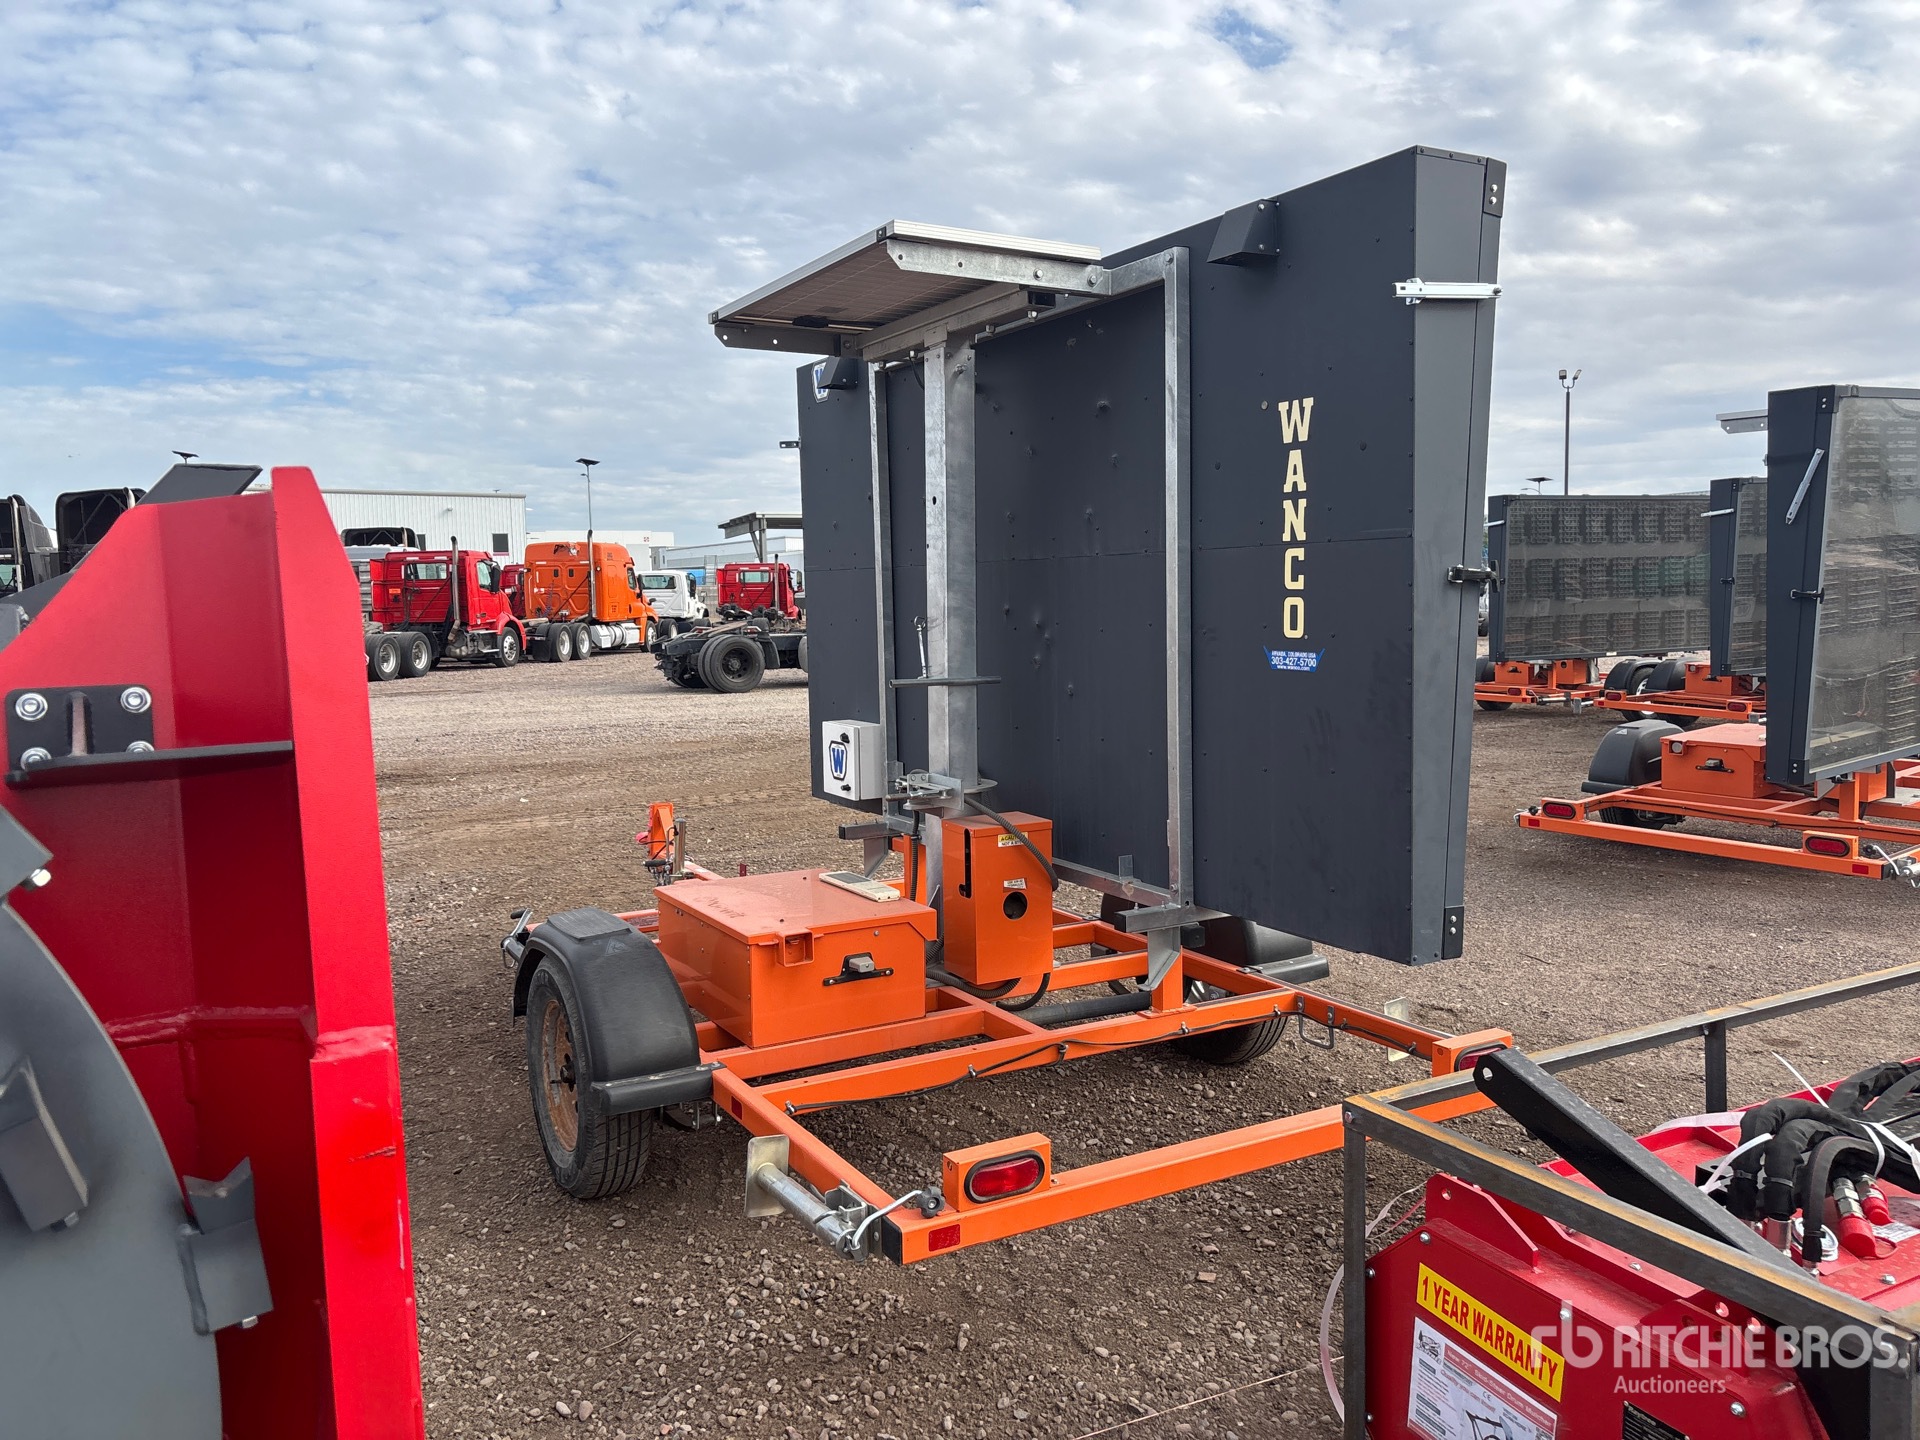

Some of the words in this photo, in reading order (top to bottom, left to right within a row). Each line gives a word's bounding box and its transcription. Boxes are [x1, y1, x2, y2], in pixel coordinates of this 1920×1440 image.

[1278, 397, 1314, 638] WANCO
[1271, 656, 1317, 667] 303-427-5700
[832, 748, 844, 774] W
[1422, 1276, 1429, 1302] 1
[1433, 1281, 1470, 1330] YEAR
[1472, 1308, 1558, 1388] WARRANTY
